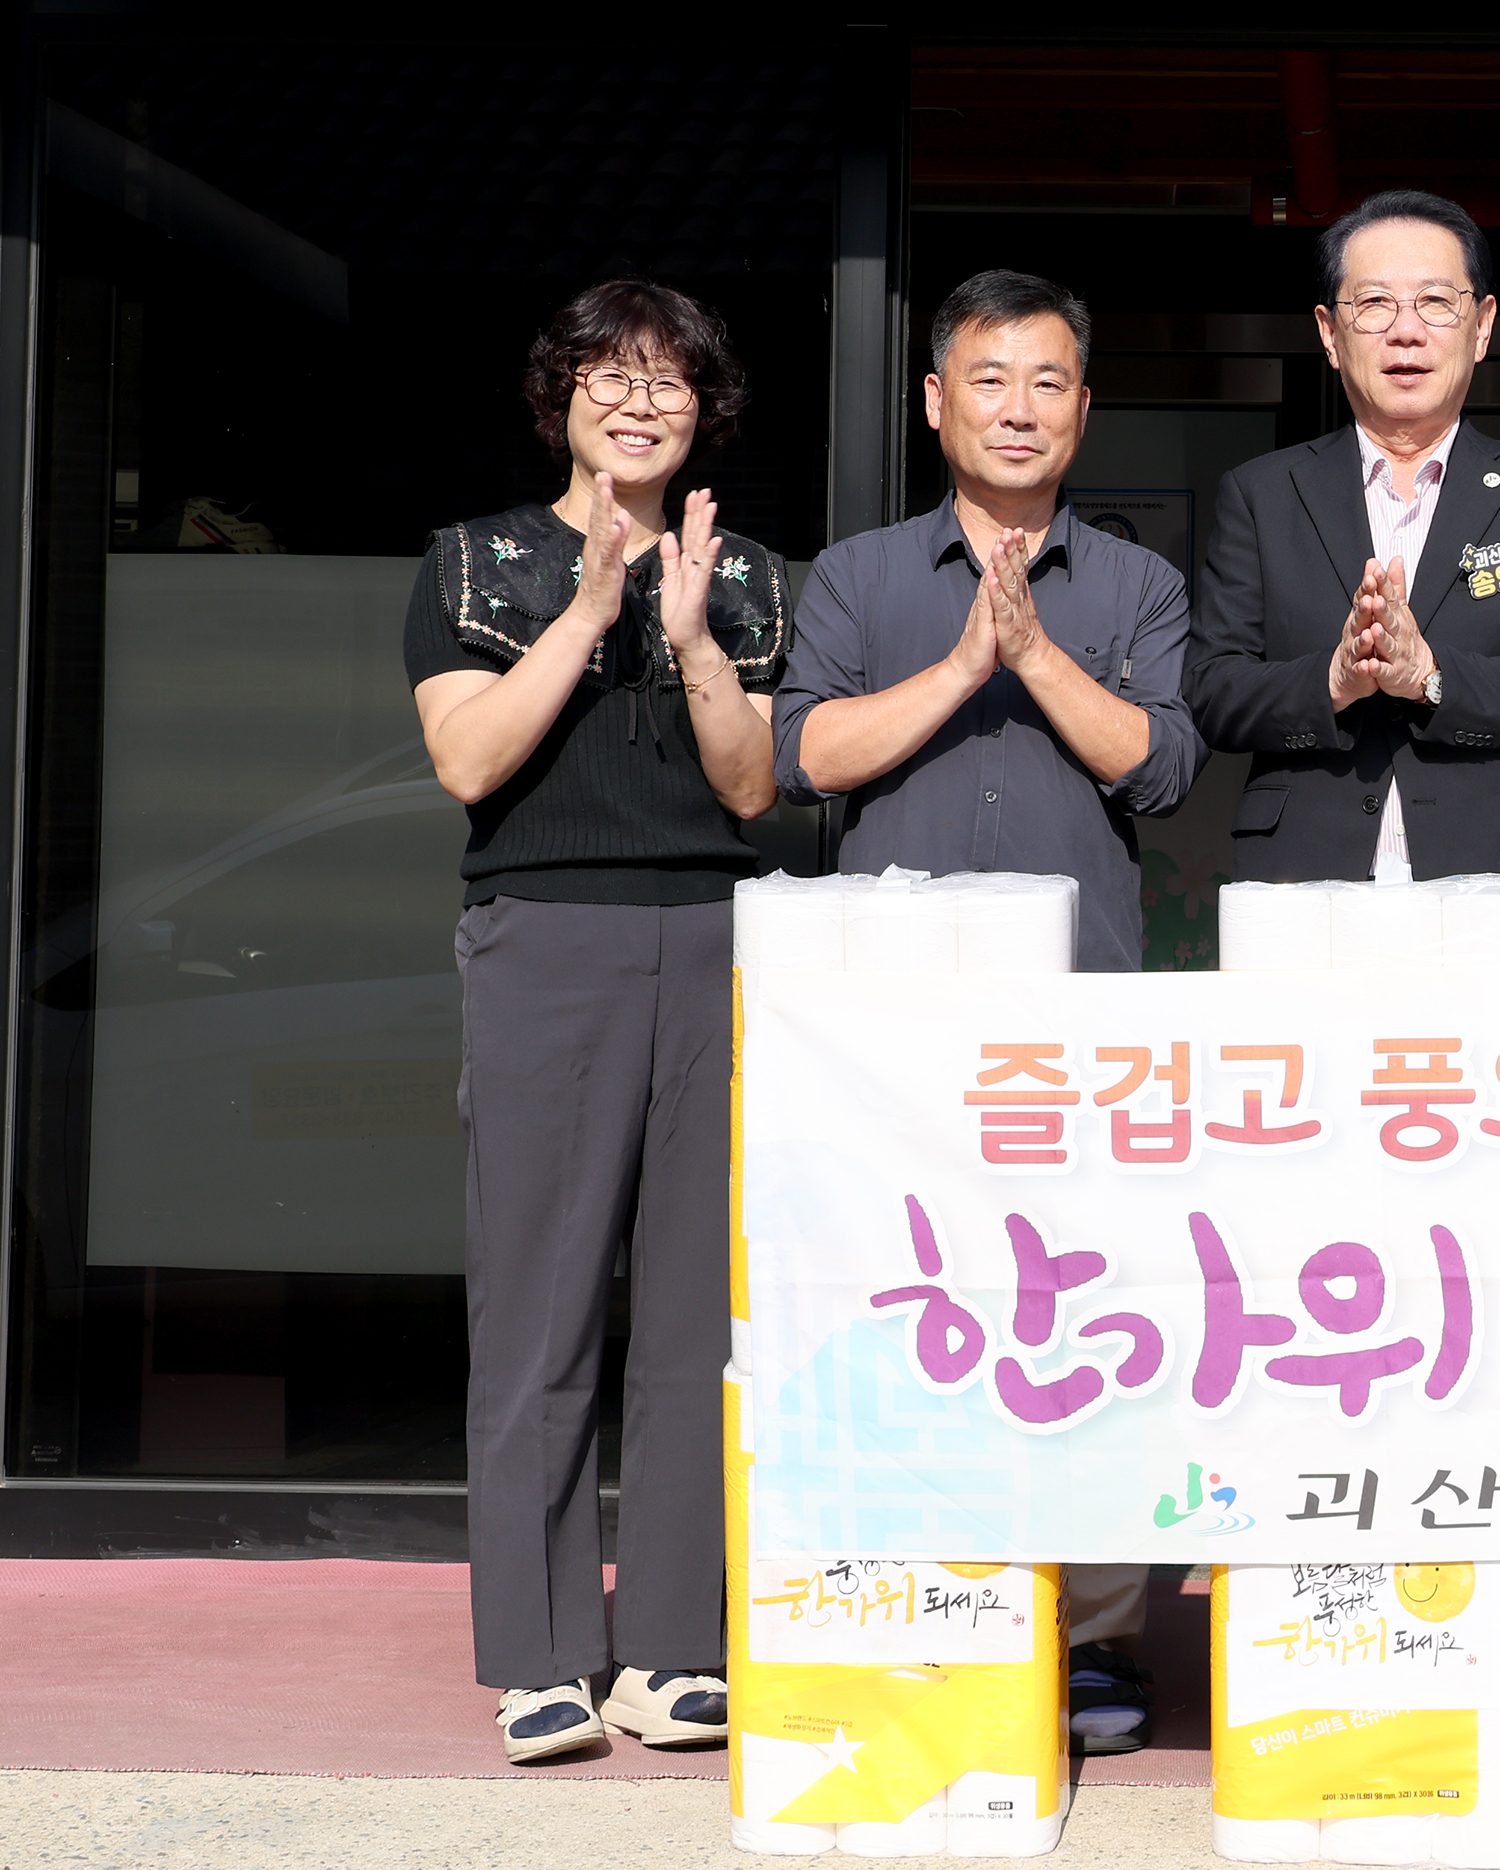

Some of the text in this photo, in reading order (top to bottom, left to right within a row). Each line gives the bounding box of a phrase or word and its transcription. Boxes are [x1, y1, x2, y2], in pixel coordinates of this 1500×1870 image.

[964, 1040, 1321, 1165] 즐겁고
[871, 1194, 1473, 1424] 한가위
[752, 1570, 916, 1628] 한가위
[923, 1586, 1010, 1629] 되세요
[1252, 1615, 1465, 1667] 한가위 되세요
[1250, 1727, 1299, 1756] 당신이
[1301, 1714, 1347, 1741] 스마트
